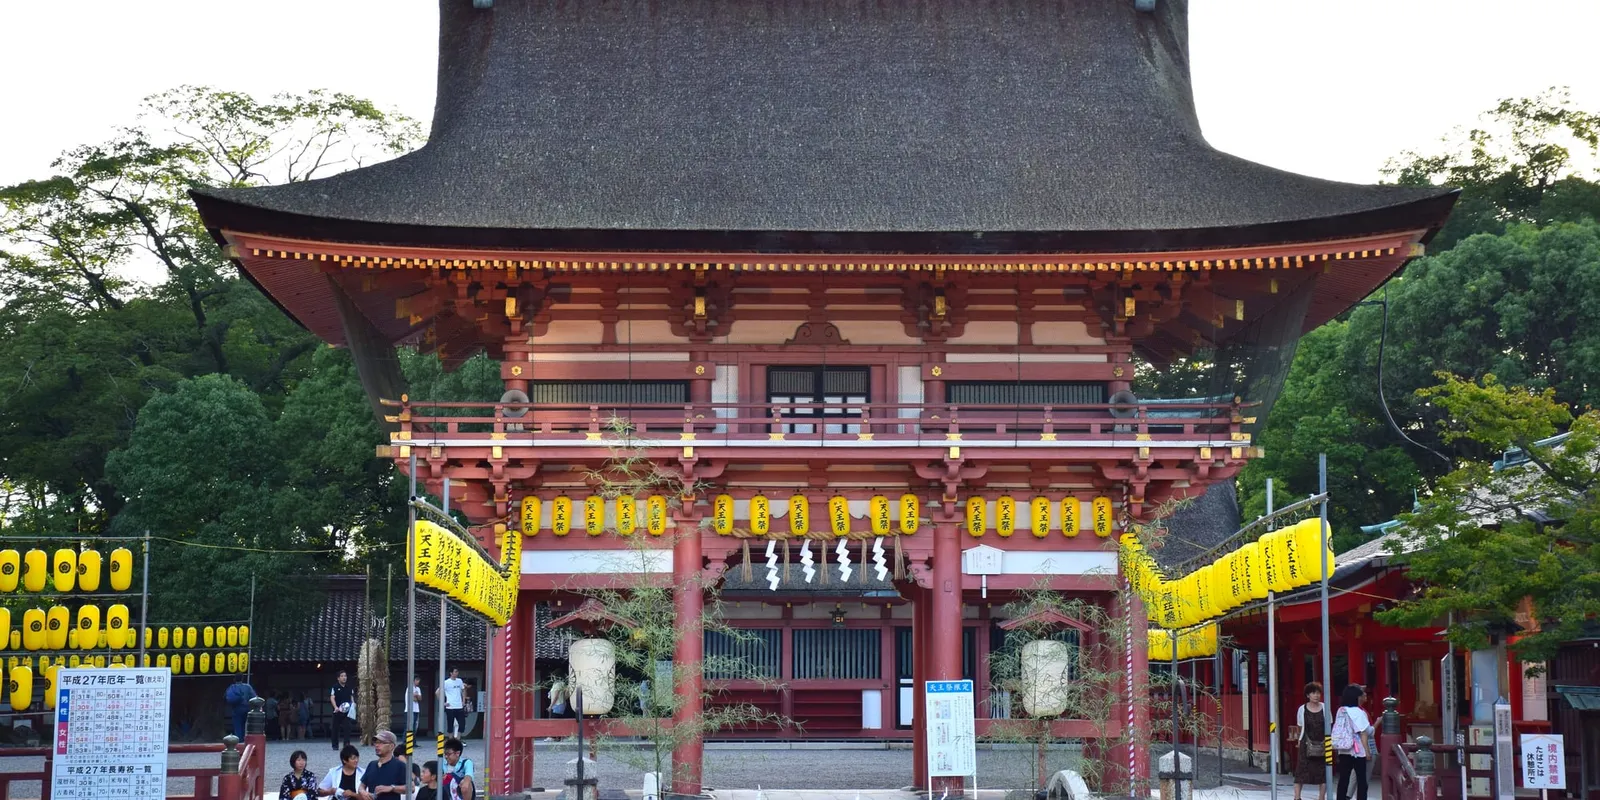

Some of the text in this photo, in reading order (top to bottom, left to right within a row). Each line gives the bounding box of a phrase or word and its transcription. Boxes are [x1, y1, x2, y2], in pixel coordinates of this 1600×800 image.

[525, 505, 533, 531] 天王祭
[556, 505, 565, 531] 天王祭
[588, 505, 596, 531] 天王祭
[622, 504, 630, 530] 天王祭
[652, 505, 660, 530] 天王祭
[717, 504, 726, 529] 天王祭
[758, 504, 766, 529] 天王祭
[795, 505, 804, 530] 天王祭
[835, 506, 845, 531] 天王祭
[880, 504, 888, 529] 天王祭
[906, 503, 915, 529] 天王祭
[973, 506, 981, 532] 天王祭
[1001, 505, 1010, 530] 天王祭
[1065, 506, 1073, 532] 天王祭
[1097, 506, 1105, 532] 天王祭
[418, 535, 432, 575] 天王祭
[63, 675, 144, 684] 平成27年厄年一覧
[930, 684, 970, 692] 天王祭限定
[61, 697, 68, 715] 男性
[59, 730, 66, 748] 女性
[68, 766, 151, 774] 平成27年長寿祝一覧
[1527, 753, 1535, 784] 休憩所で
[1536, 747, 1544, 776] たばこは
[1548, 744, 1559, 784] 境内禁煙
